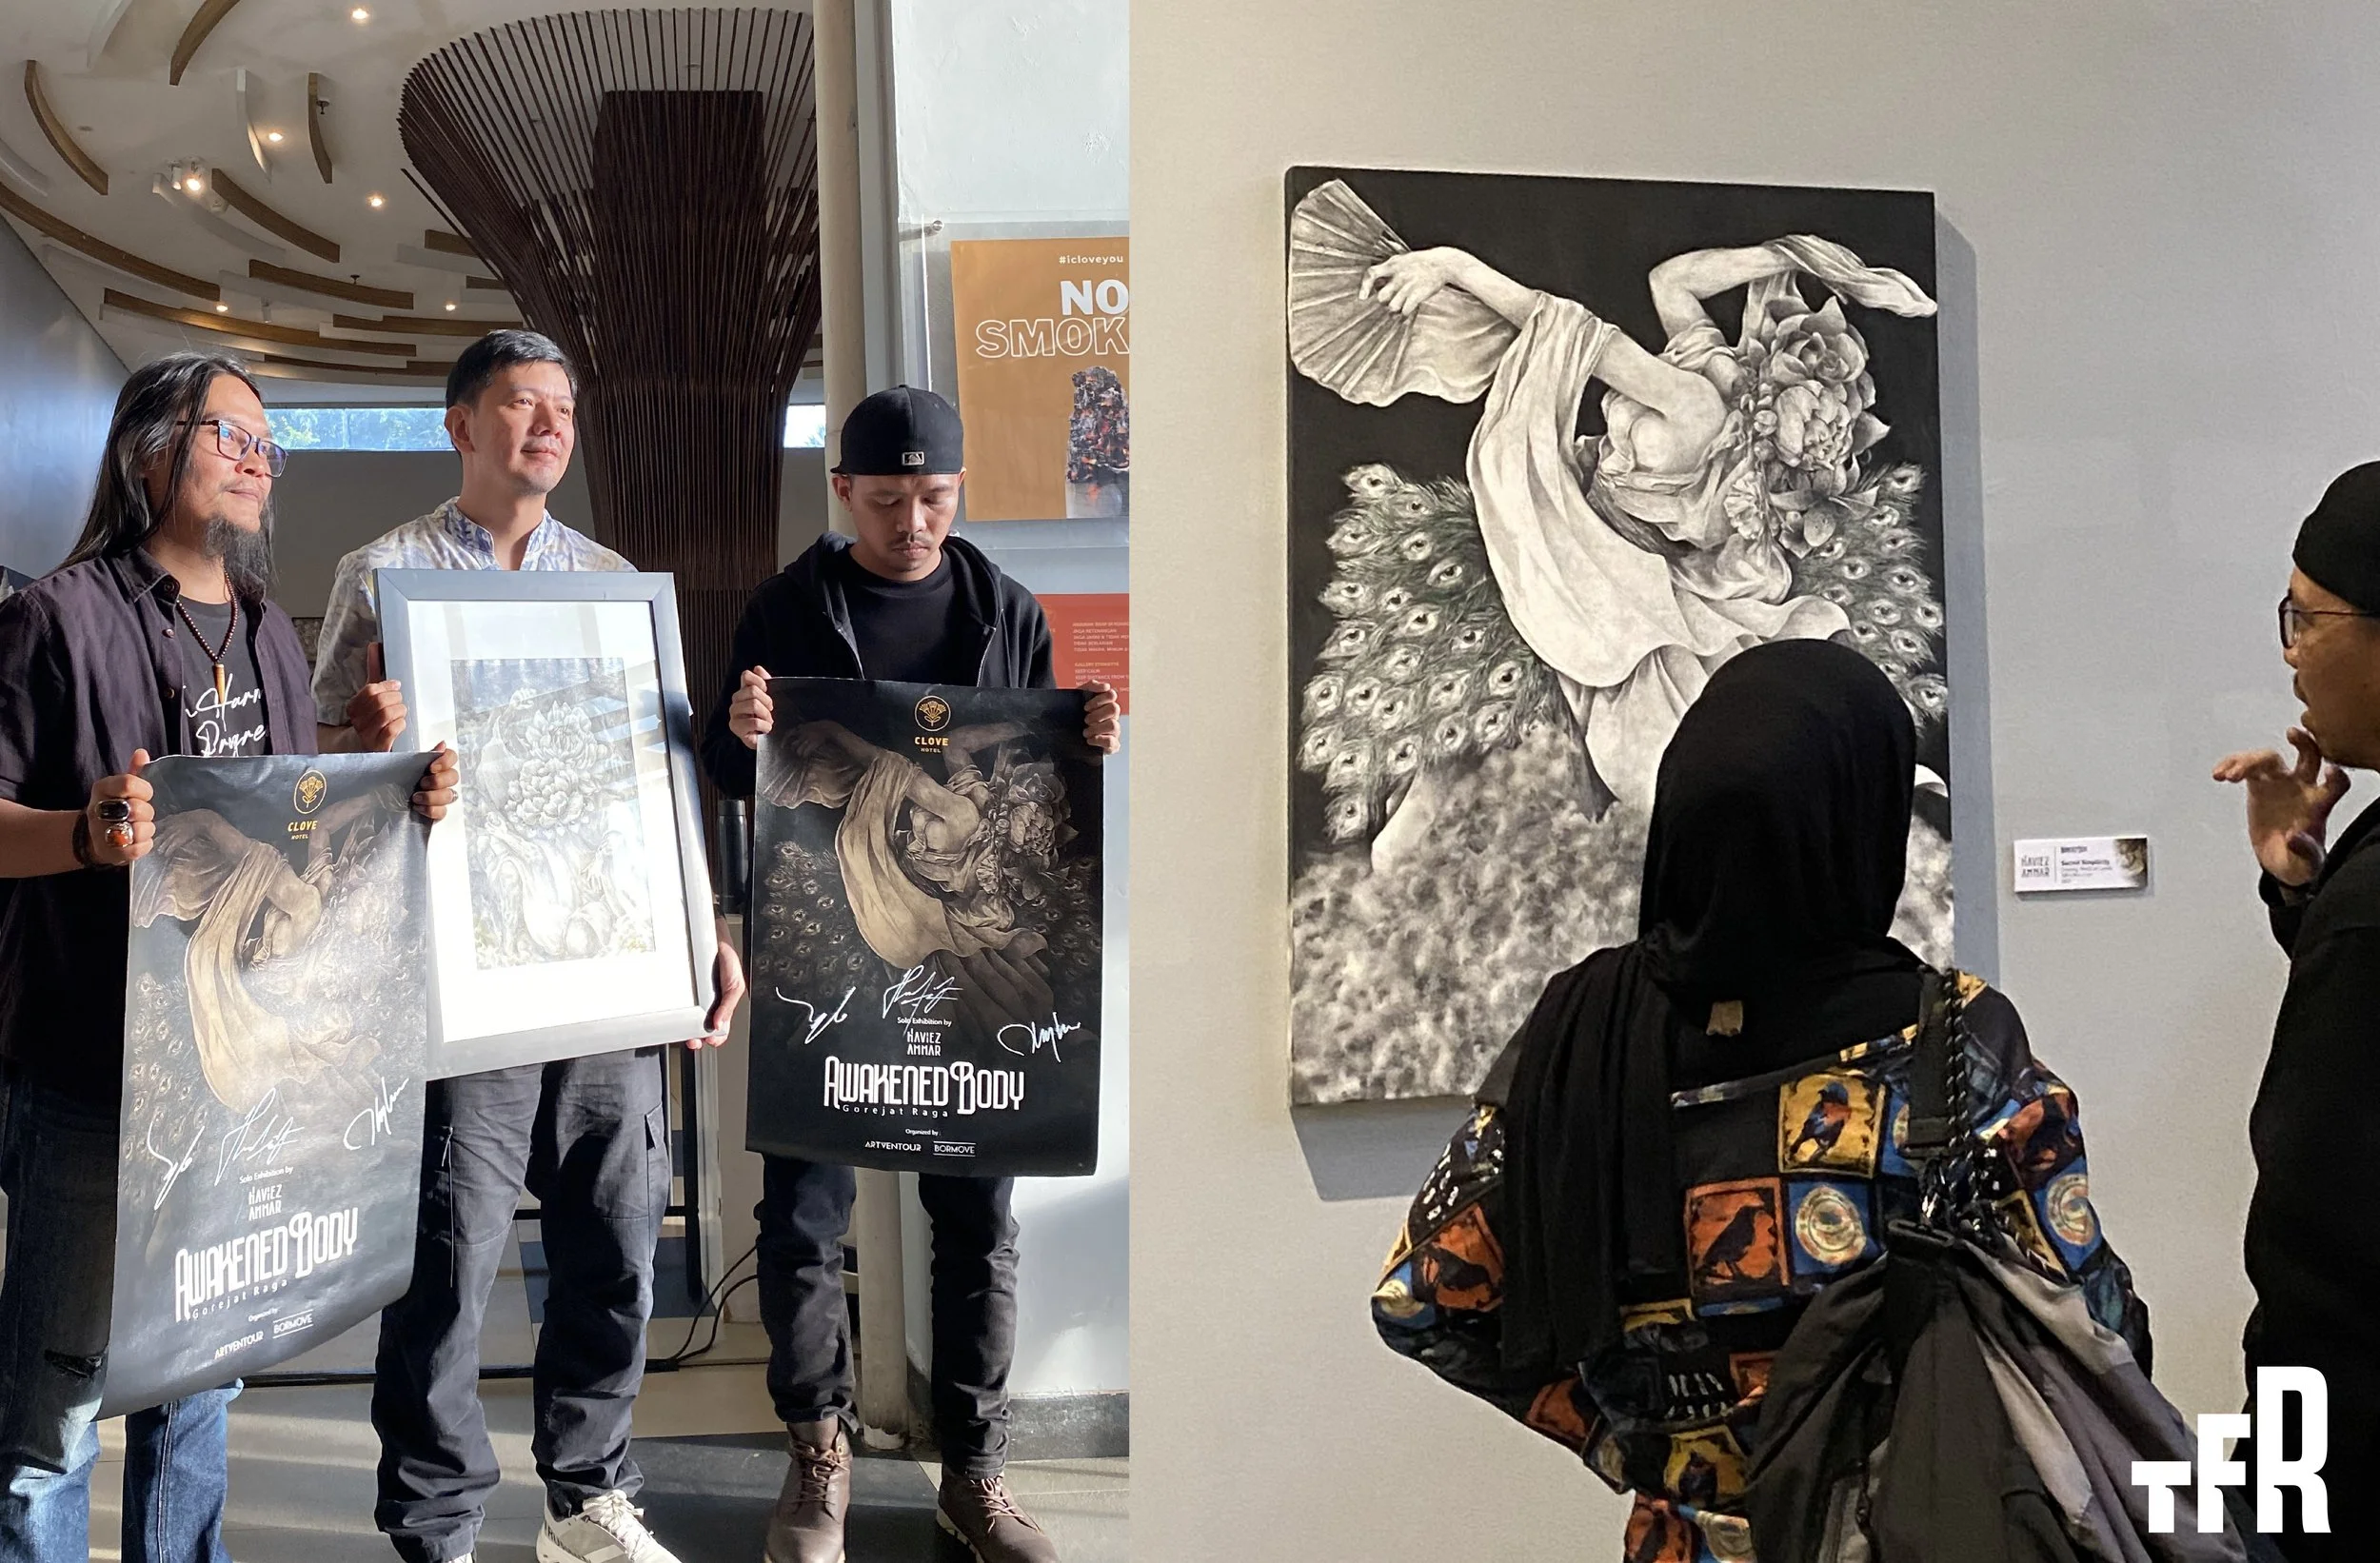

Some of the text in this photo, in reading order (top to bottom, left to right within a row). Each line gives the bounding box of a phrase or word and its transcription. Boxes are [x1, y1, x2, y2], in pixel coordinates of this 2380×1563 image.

[1059, 255, 1124, 266] #icloveyou
[1060, 279, 1129, 316] NO
[914, 737, 949, 746] CLOVE
[288, 821, 318, 832] CLOVE
[943, 1019, 952, 1028] by
[906, 1028, 942, 1044] HAVIEZ
[906, 1043, 942, 1057] AMMAR
[843, 1104, 948, 1118] Gorejat Raga
[864, 1141, 975, 1154] ARTVENTOUR BORMOVE
[239, 1165, 293, 1184] Solo Exhibition by
[248, 1184, 282, 1205] HAVIEZ
[192, 1279, 288, 1319] Gorejat Raga
[273, 1314, 313, 1334] BORMOVE
[214, 1331, 264, 1359] ARTVENTOUR
